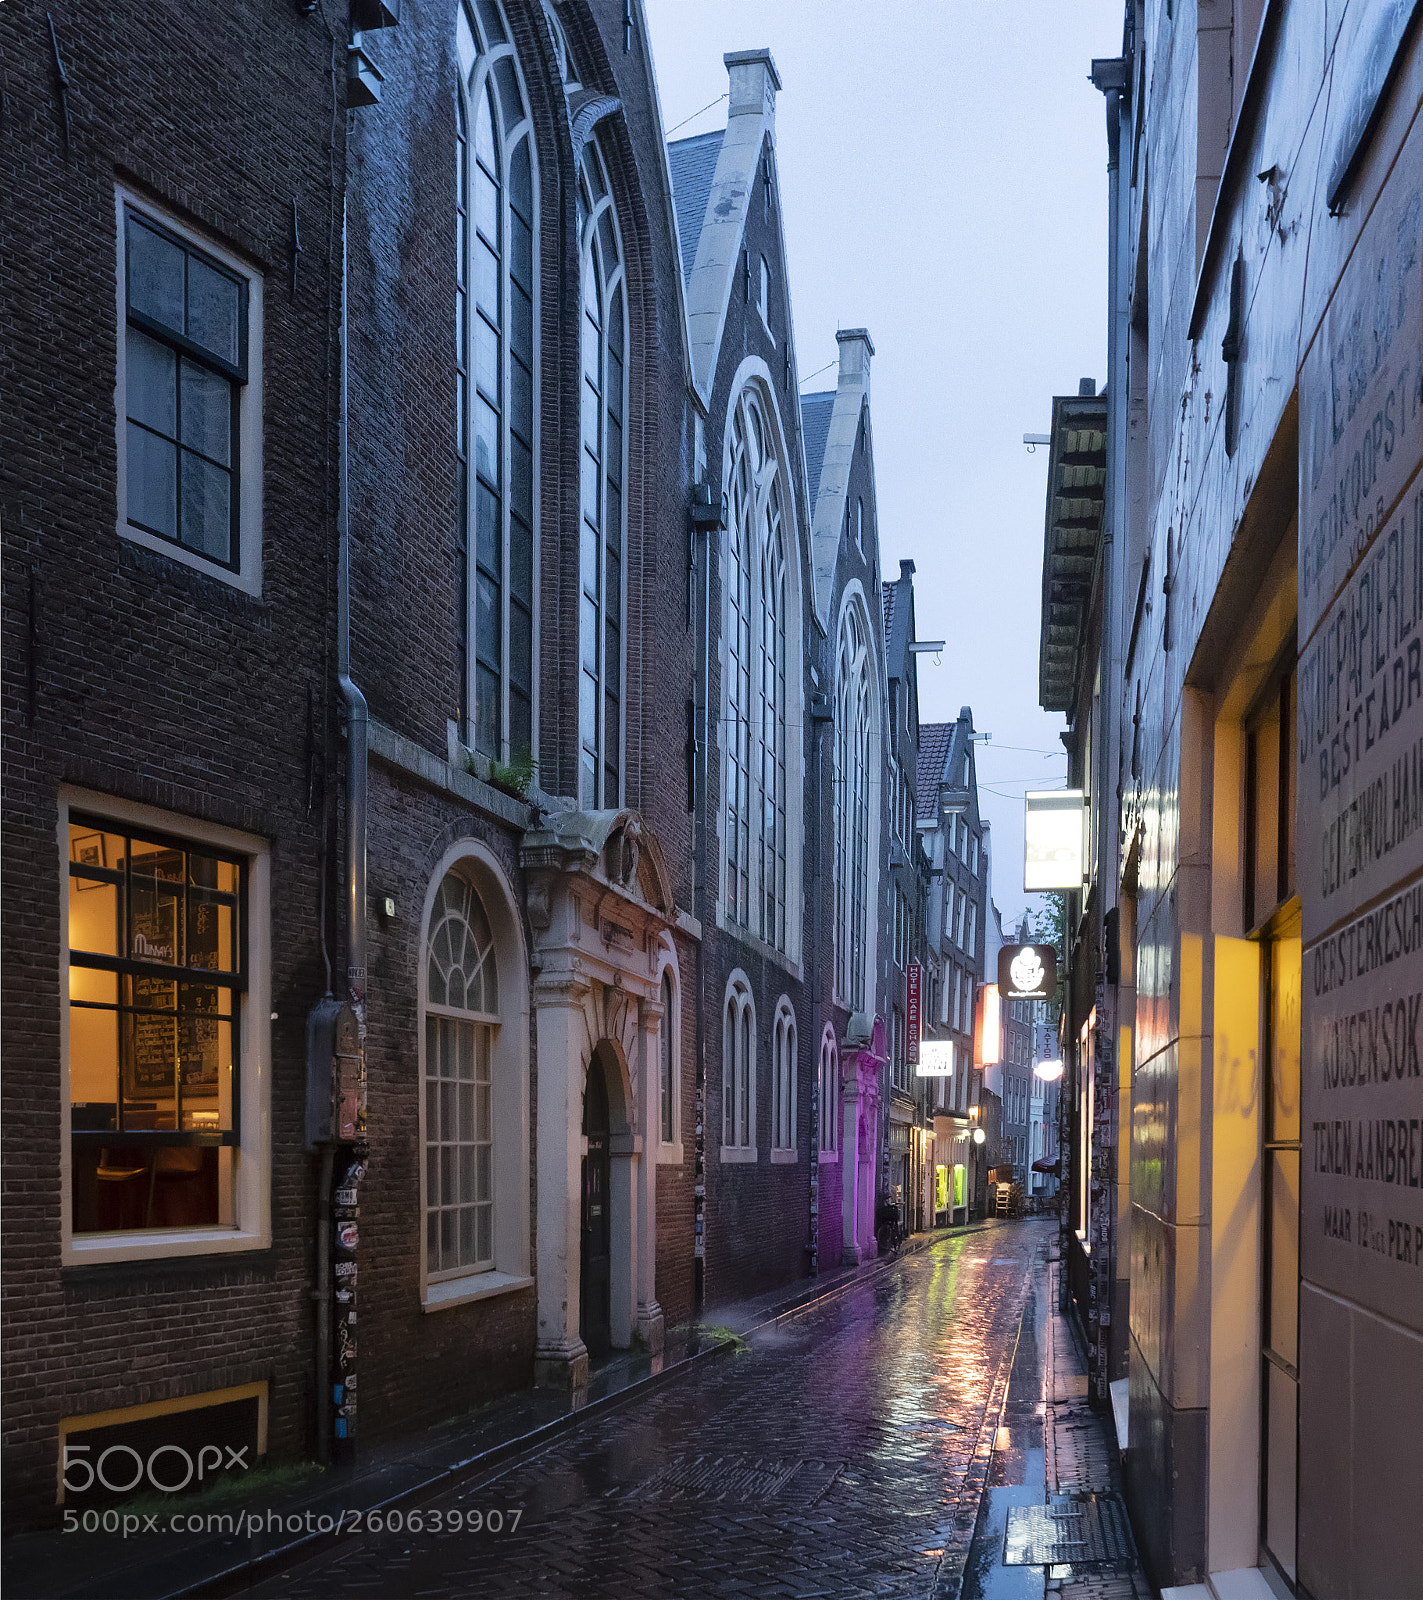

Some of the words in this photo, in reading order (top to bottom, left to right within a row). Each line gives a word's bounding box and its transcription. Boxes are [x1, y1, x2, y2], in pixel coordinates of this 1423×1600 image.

[910, 967, 918, 995] HOTEL
[909, 999, 918, 1020] CAFE
[1043, 1027, 1051, 1059] TATTOO
[1324, 1206, 1351, 1242] MAAR
